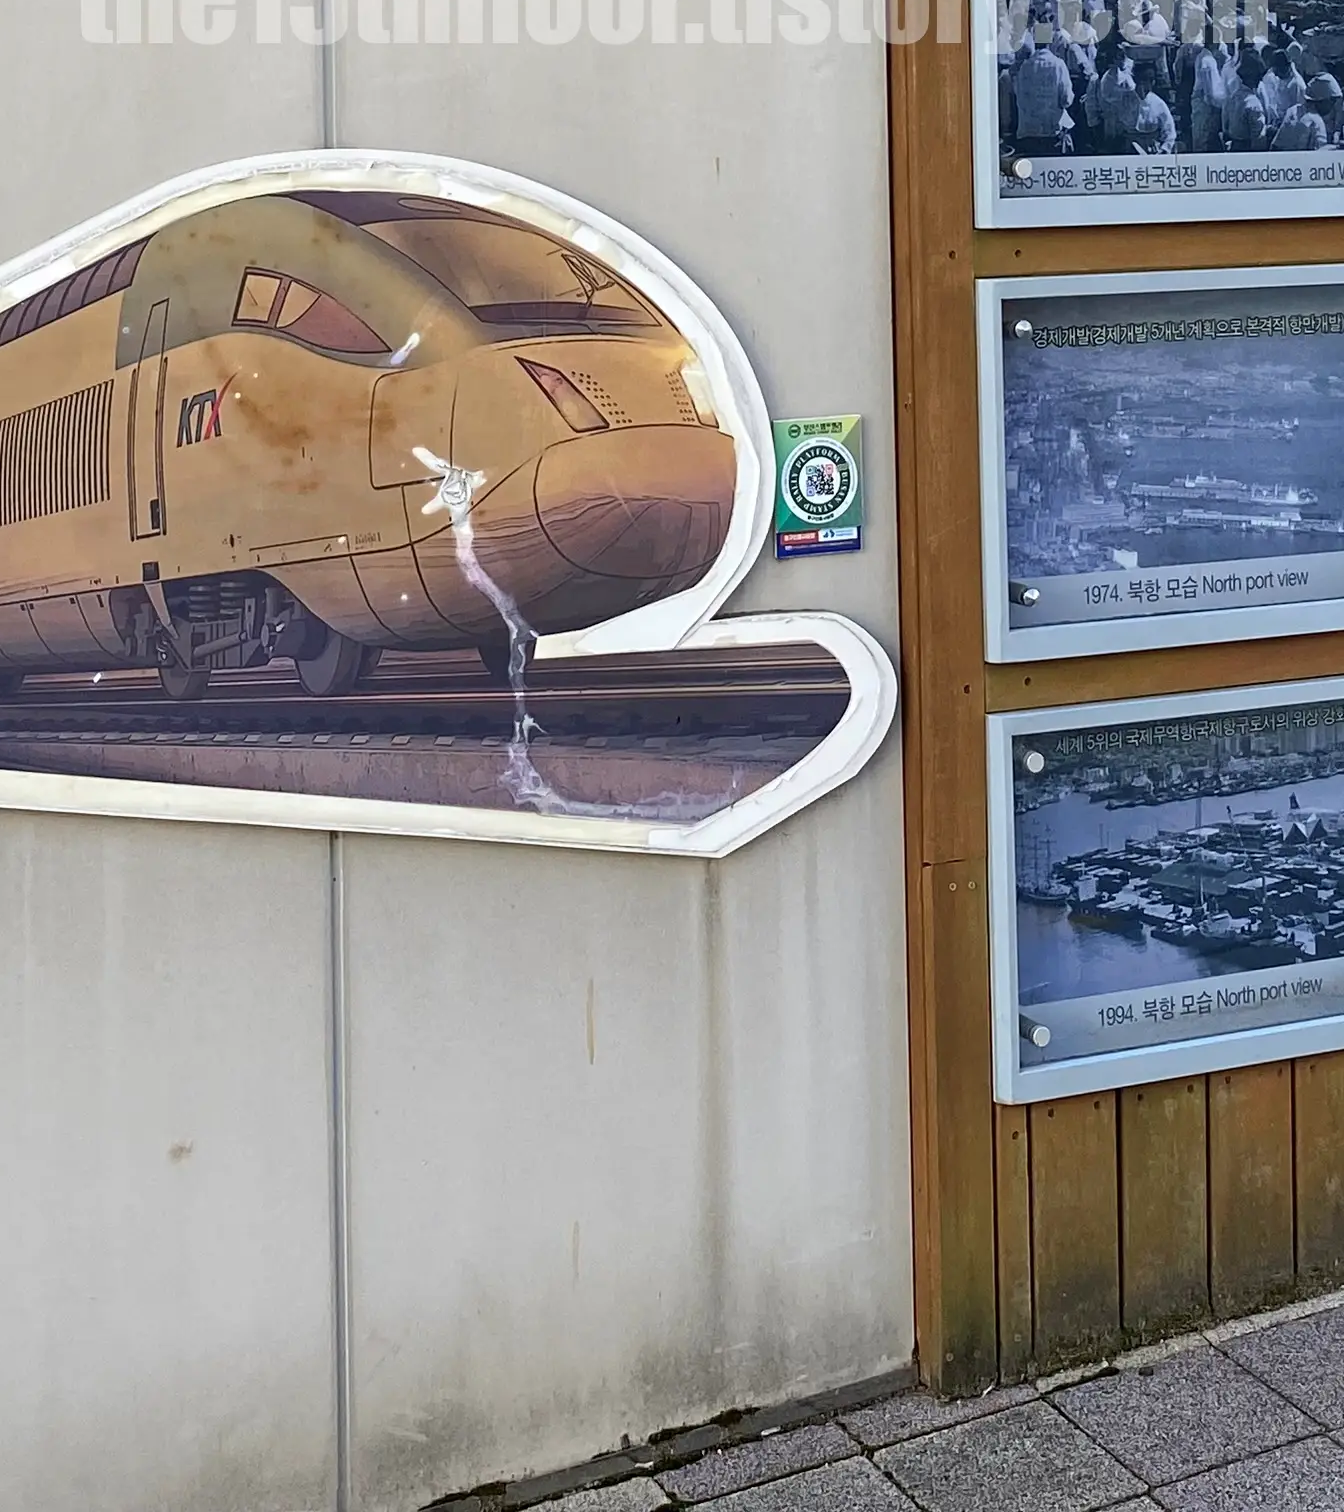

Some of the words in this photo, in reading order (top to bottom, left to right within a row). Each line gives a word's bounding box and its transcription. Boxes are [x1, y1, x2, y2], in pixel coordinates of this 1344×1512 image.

[1081, 168, 1131, 191] 광복과
[1134, 166, 1198, 189] 한국전쟁
[1206, 164, 1303, 186] Independence
[1309, 163, 1336, 183] and
[1032, 323, 1150, 350] 경제개발(경제개발
[1150, 322, 1185, 342] 5개년
[1188, 318, 1245, 340] 계획으로
[1246, 314, 1288, 337] 본격적
[176, 374, 238, 448] KTX
[1083, 584, 1124, 606] 1974.
[1127, 579, 1162, 604] 북항
[1165, 576, 1198, 599] 모습
[1202, 572, 1243, 596] North
[1246, 570, 1275, 594] port
[1277, 567, 1309, 589] view
[1055, 735, 1085, 756] 세계
[1086, 731, 1123, 753] 5위의
[1292, 707, 1319, 727] 위상
[1097, 1007, 1138, 1029] 1994.
[1141, 996, 1176, 1022] 북항
[1179, 992, 1213, 1017] 모습
[1216, 986, 1256, 1010] North
[1259, 981, 1288, 1006] port
[1290, 974, 1324, 997] view
